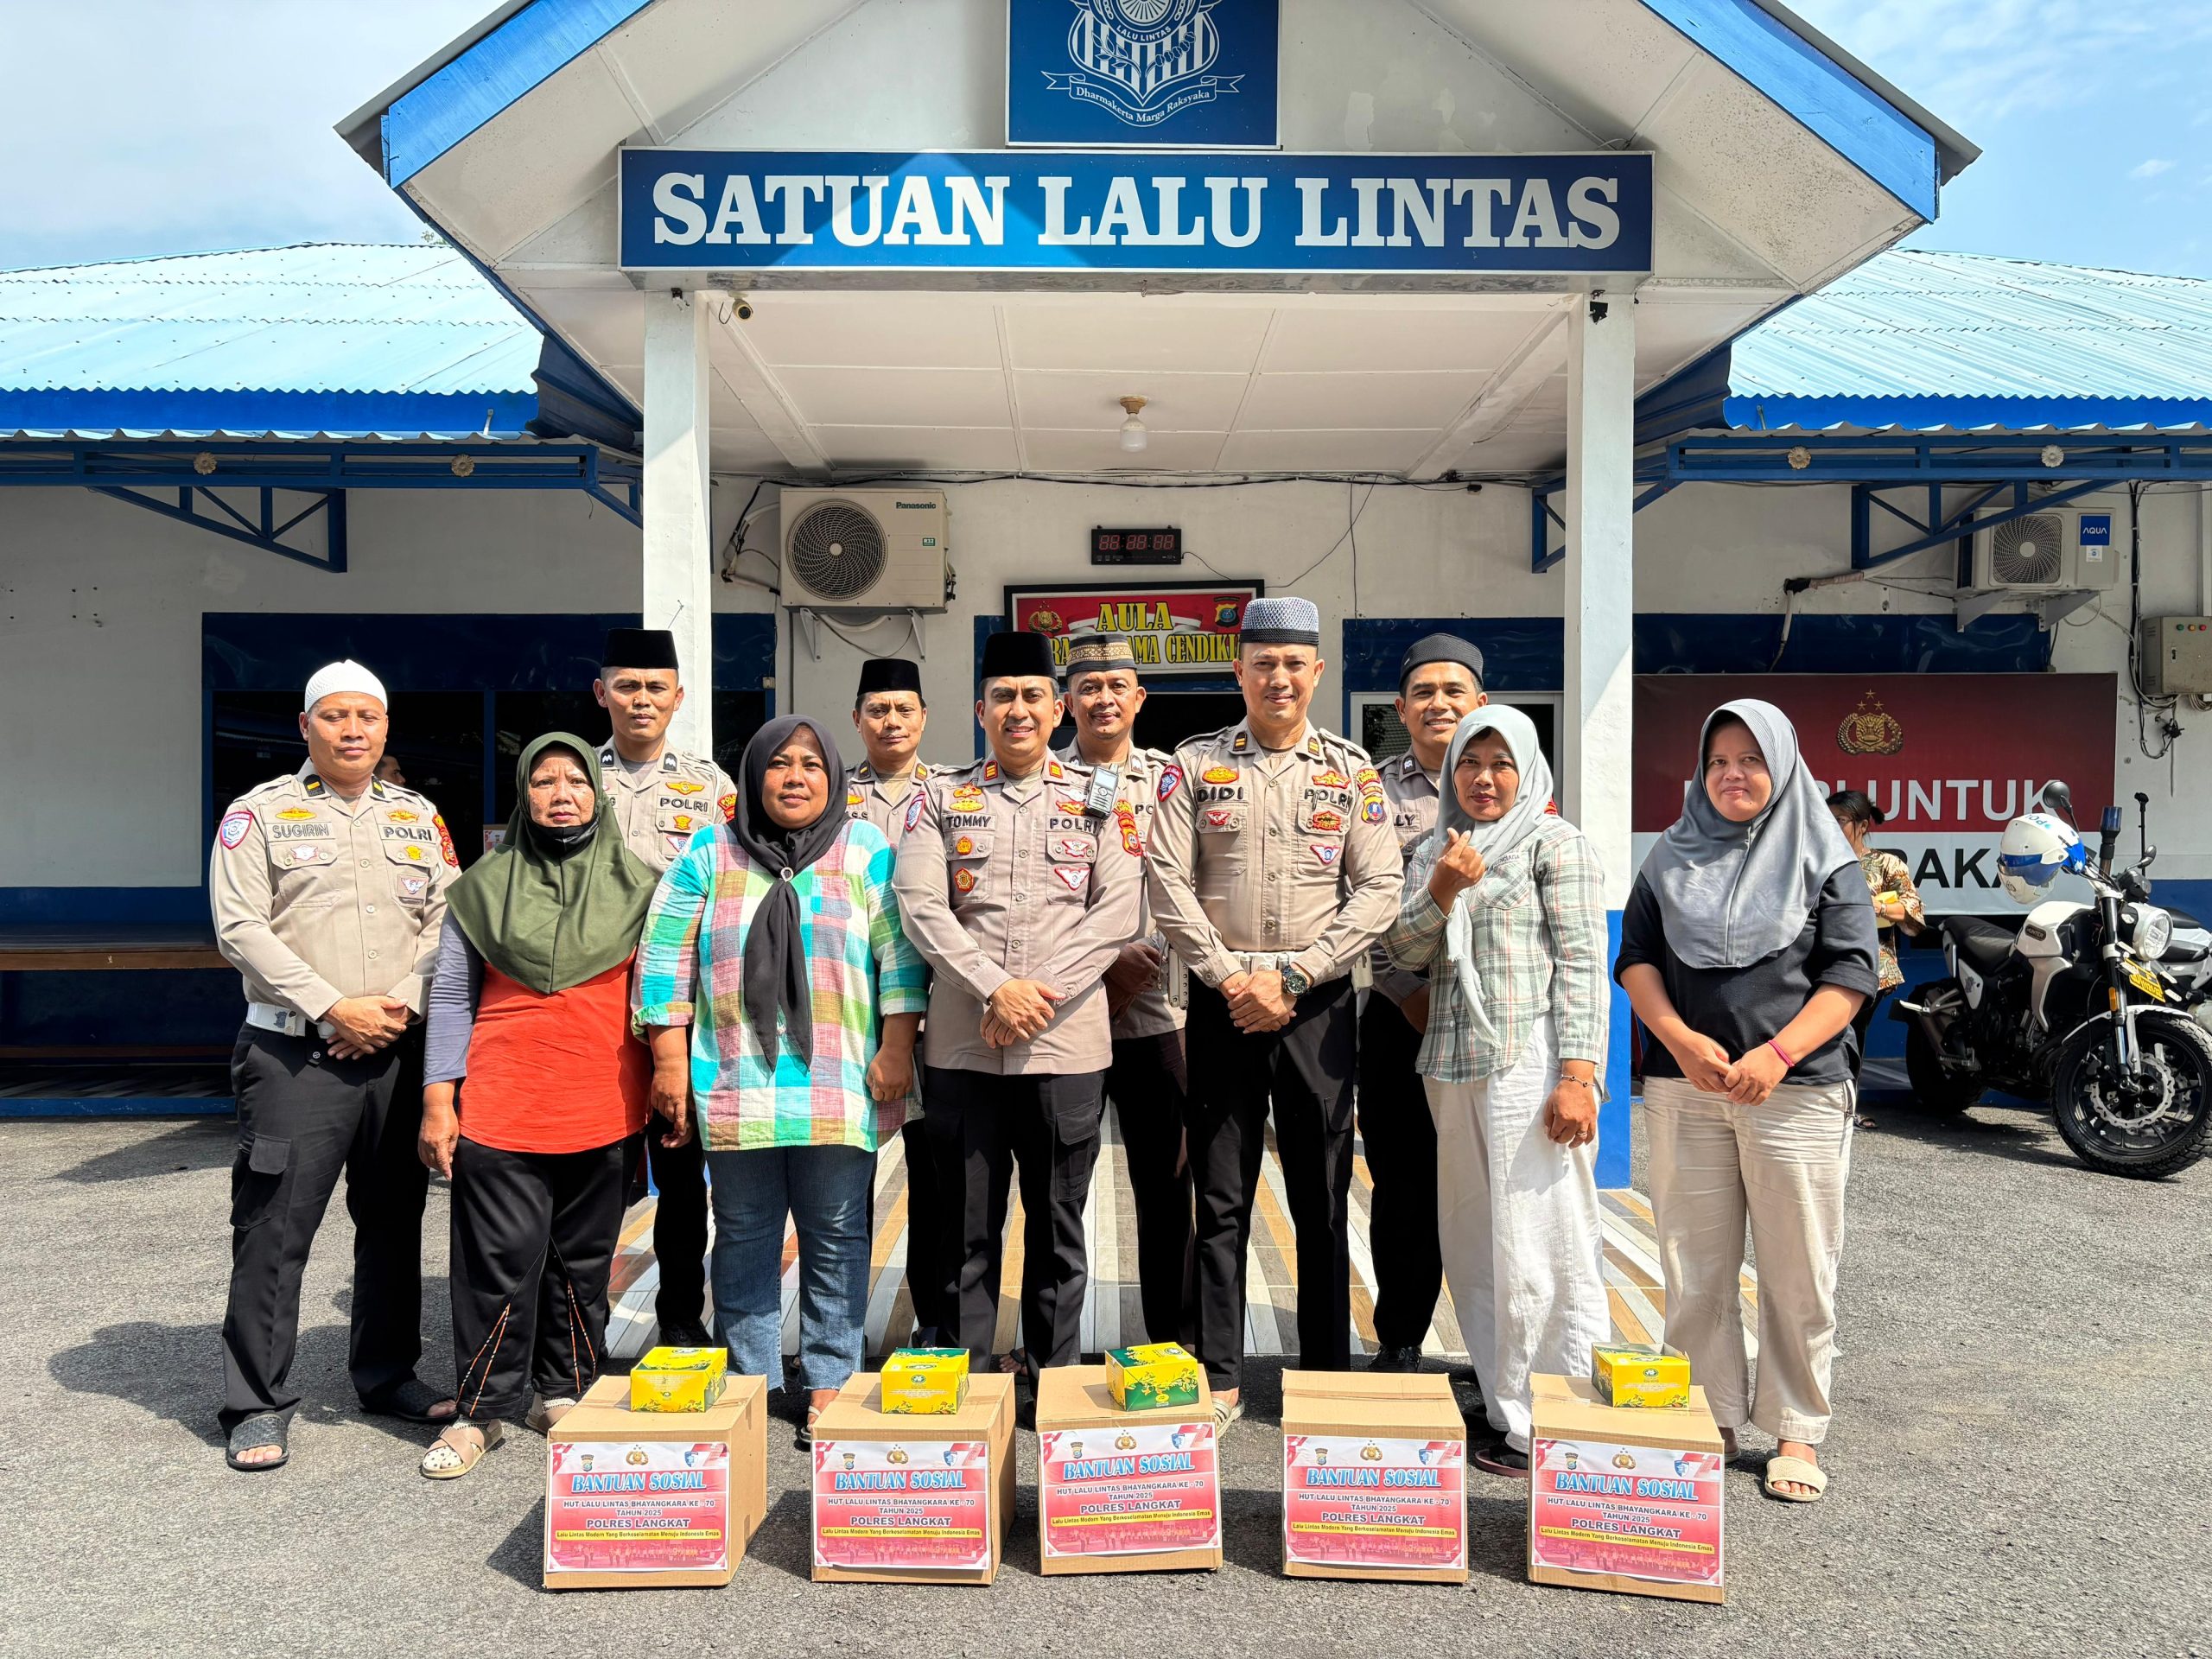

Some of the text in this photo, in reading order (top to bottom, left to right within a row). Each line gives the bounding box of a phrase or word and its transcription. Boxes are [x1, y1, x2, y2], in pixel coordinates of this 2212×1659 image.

[1116, 25, 1172, 41] LALU LINTAS
[1077, 86, 1210, 123] Dharmakerta Marga Raksyaka
[652, 172, 1619, 250] SATUAN LALU LINTAS
[1096, 602, 1173, 632] AULA
[1166, 634, 1241, 664] CENDIKI
[1196, 786, 1243, 802] DIDI
[659, 798, 708, 812] POLRI
[946, 815, 991, 828] TOMMY
[272, 823, 330, 838] SUGIRIN
[383, 826, 432, 841] POLRI
[1063, 1452, 1196, 1481] BANTUAN SOSIAL
[572, 1471, 707, 1492] BANTUAN SOSIAL
[835, 1471, 967, 1491] BANTUAN SOSIAL
[1306, 1468, 1442, 1488] BANTUAN SOSIAL
[1555, 1472, 1699, 1502] BANTUAN SOSIAL
[1081, 1500, 1181, 1513] POLRES LANGKAT
[1588, 1501, 1615, 1510] LINTAS
[1618, 1504, 1677, 1517] BHAYANGKARA
[635, 1519, 690, 1528] LANGKAT
[850, 1517, 951, 1526] POLRES LANGKAT
[1322, 1513, 1425, 1524] POLRES LANGKAT
[1572, 1519, 1681, 1538] POLRES LANGKAT
